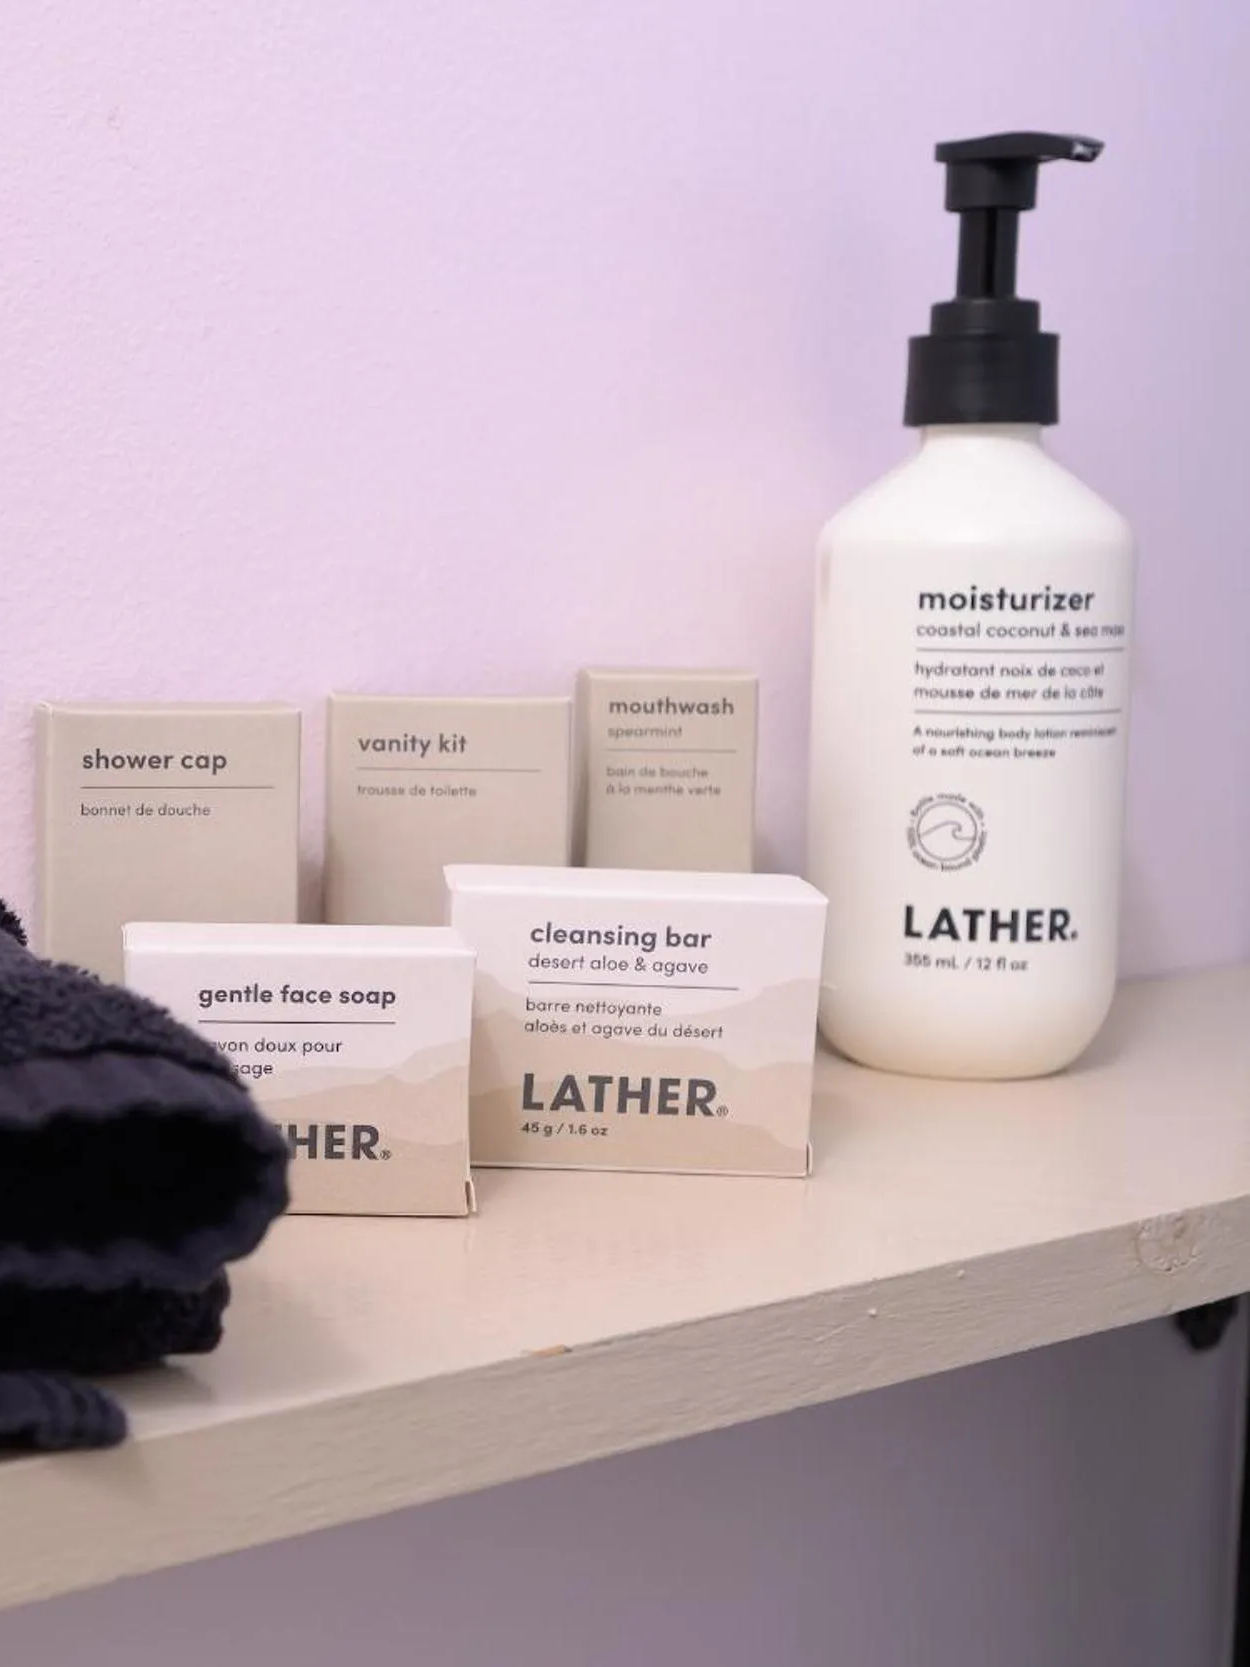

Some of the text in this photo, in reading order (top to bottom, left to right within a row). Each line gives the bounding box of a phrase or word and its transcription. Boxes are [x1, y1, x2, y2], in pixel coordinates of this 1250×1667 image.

[918, 585, 1095, 611] moisturizer
[916, 623, 981, 638] coastal
[985, 623, 1056, 638] coconut
[1060, 621, 1071, 638] &
[1075, 624, 1099, 638] sea
[914, 660, 996, 679] hydratant
[999, 662, 1033, 677] noix
[1037, 661, 1056, 677] de
[913, 686, 975, 700] mousse
[979, 684, 1001, 700] de
[1005, 687, 1038, 700] mer
[1042, 685, 1061, 700] de
[1063, 683, 1077, 700] la
[609, 696, 735, 715] mouthwash
[607, 726, 682, 741] spearmint
[912, 725, 923, 737] A
[925, 726, 995, 742] nourishing
[999, 726, 1031, 741] body
[358, 733, 467, 759] vanity kit
[940, 745, 965, 758] soft
[969, 748, 1010, 759] ocean
[82, 748, 228, 775] shower cap
[357, 784, 477, 798] trousse de toilette
[80, 803, 211, 817] bonnet de douche
[530, 922, 712, 952] cleansing bar
[528, 954, 709, 977] desert aloe & agave
[903, 951, 932, 968] 355
[935, 955, 959, 970] mL
[976, 956, 991, 972] 12
[1010, 959, 1029, 972] oz
[199, 983, 396, 1009] gentle face soap
[526, 998, 663, 1018] barre nettoyante
[524, 1019, 723, 1039] aloès et agave du désert
[212, 1038, 343, 1057] von doux pour
[521, 1121, 539, 1133] 45
[544, 1124, 553, 1137] g
[568, 1123, 587, 1135] 1.6
[591, 1126, 608, 1136] oz
